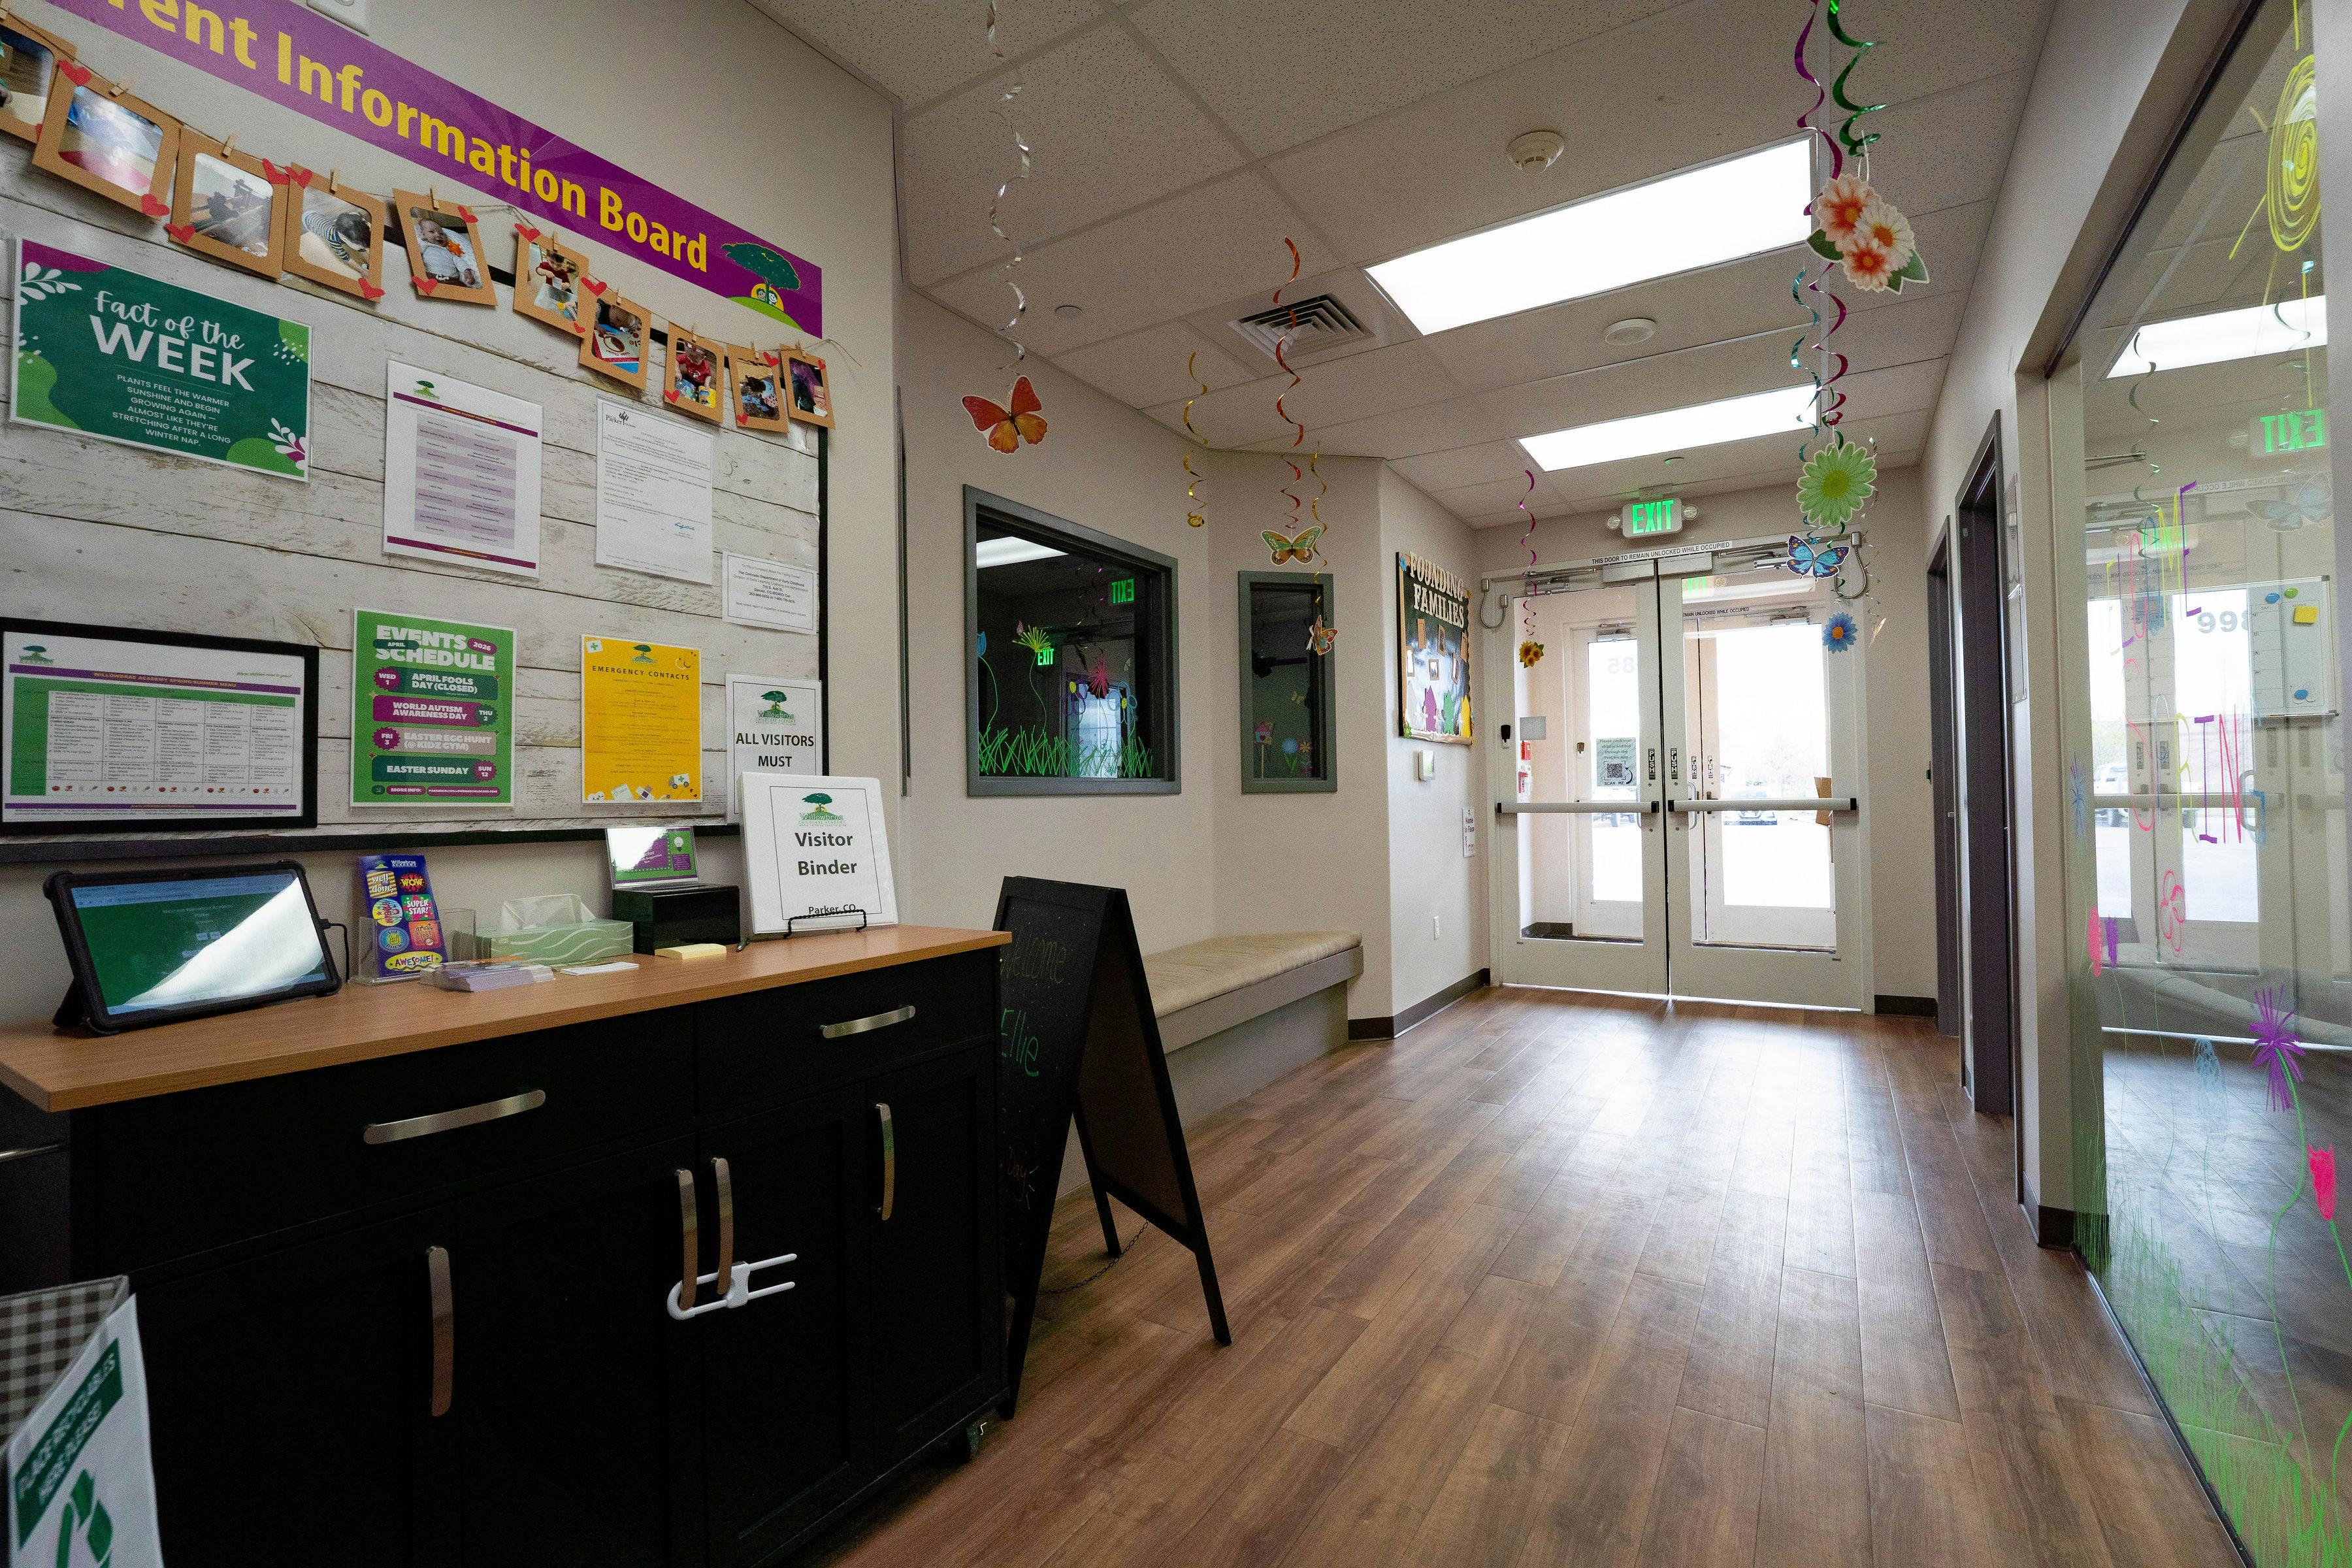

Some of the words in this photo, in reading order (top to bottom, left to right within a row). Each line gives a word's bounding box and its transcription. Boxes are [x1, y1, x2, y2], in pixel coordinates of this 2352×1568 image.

[109, 0, 256, 69] ent
[278, 31, 586, 218] Information
[599, 186, 708, 273] Board
[93, 290, 160, 327] Fact
[165, 316, 194, 339] of
[201, 320, 245, 350] the
[90, 314, 255, 392] WEEK
[117, 374, 151, 387] PLANTS
[154, 384, 172, 393] FEEL
[174, 388, 190, 397] THE
[192, 393, 229, 407] WARMER
[127, 387, 171, 402] SUNSHINE
[174, 398, 193, 407] AND
[195, 404, 220, 414] BEGIN
[131, 397, 176, 412] GROWING
[178, 408, 206, 419] AGAIN
[127, 406, 164, 419] ALMOST
[167, 415, 183, 423] LIKE
[186, 418, 218, 431] THEY'RE
[112, 412, 169, 429] STRETCHING
[172, 426, 197, 436] AFTER
[208, 434, 231, 444] LONG
[146, 429, 178, 441] WINTER
[181, 436, 201, 446] NAP.
[1632, 500, 1674, 534] EXIT
[1651, 549, 1680, 557] UNLOCKED
[1701, 542, 1730, 551] OCCUPIED
[1410, 551, 1464, 602] FOUNDING
[1413, 583, 1464, 629] FAMILIES
[376, 625, 466, 650] EVENTS
[473, 642, 491, 651] 2026
[375, 648, 495, 671] SCHEDULE
[1037, 648, 1054, 666] EXIT
[412, 673, 441, 683] APRIL
[442, 676, 473, 685] FOOLS
[592, 665, 644, 676] EMERGENCY
[648, 671, 689, 680] CONTACTS
[434, 684, 478, 694] (CLOSED)
[393, 710, 448, 719] AWARENESS
[428, 704, 463, 713] AUTISM
[404, 732, 443, 742] EASTER
[736, 733, 759, 744] ALL
[761, 734, 814, 747] VISITORS
[417, 741, 442, 749] KIDZ
[442, 743, 469, 751] GYM)
[758, 756, 792, 767] MUST
[427, 766, 469, 775] SUNDAY
[794, 832, 853, 847] Visitor
[798, 859, 857, 875] Binder
[372, 874, 389, 883] well
[416, 924, 433, 935] great
[395, 955, 434, 967] AWESOME!
